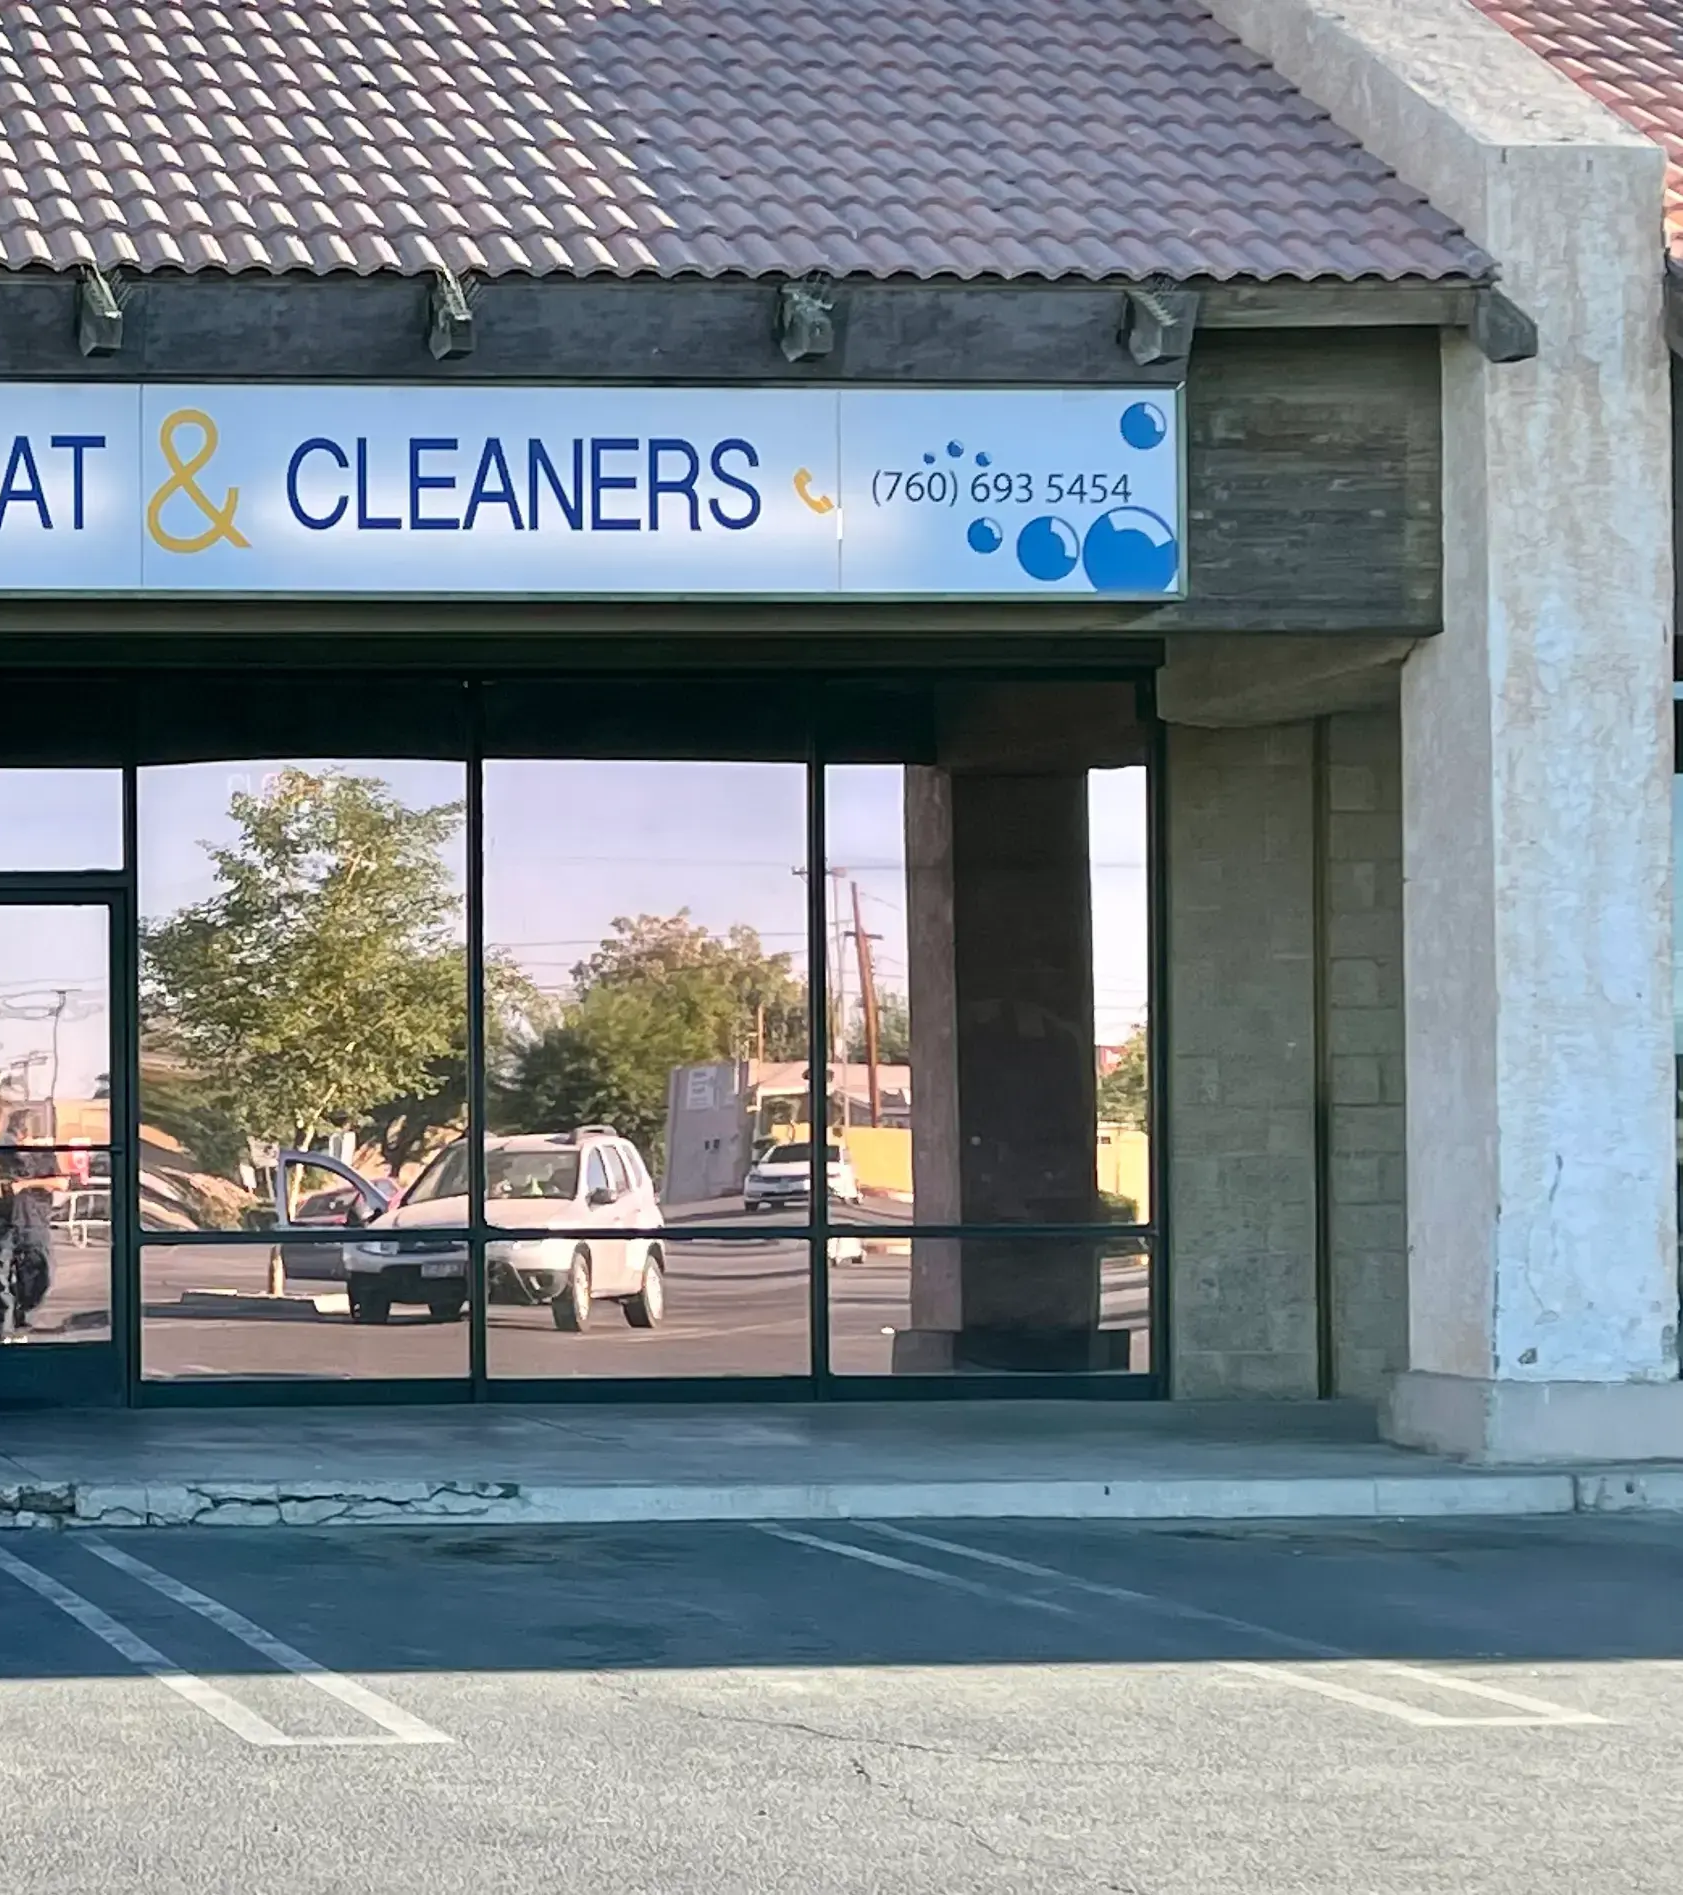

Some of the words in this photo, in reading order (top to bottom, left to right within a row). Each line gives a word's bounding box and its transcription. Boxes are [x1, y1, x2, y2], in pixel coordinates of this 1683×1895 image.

[146, 408, 252, 554] &
[287, 437, 762, 532] CLEANERS
[872, 469, 959, 507] (760)
[971, 472, 1033, 504] 693
[1046, 473, 1132, 504] 5454
